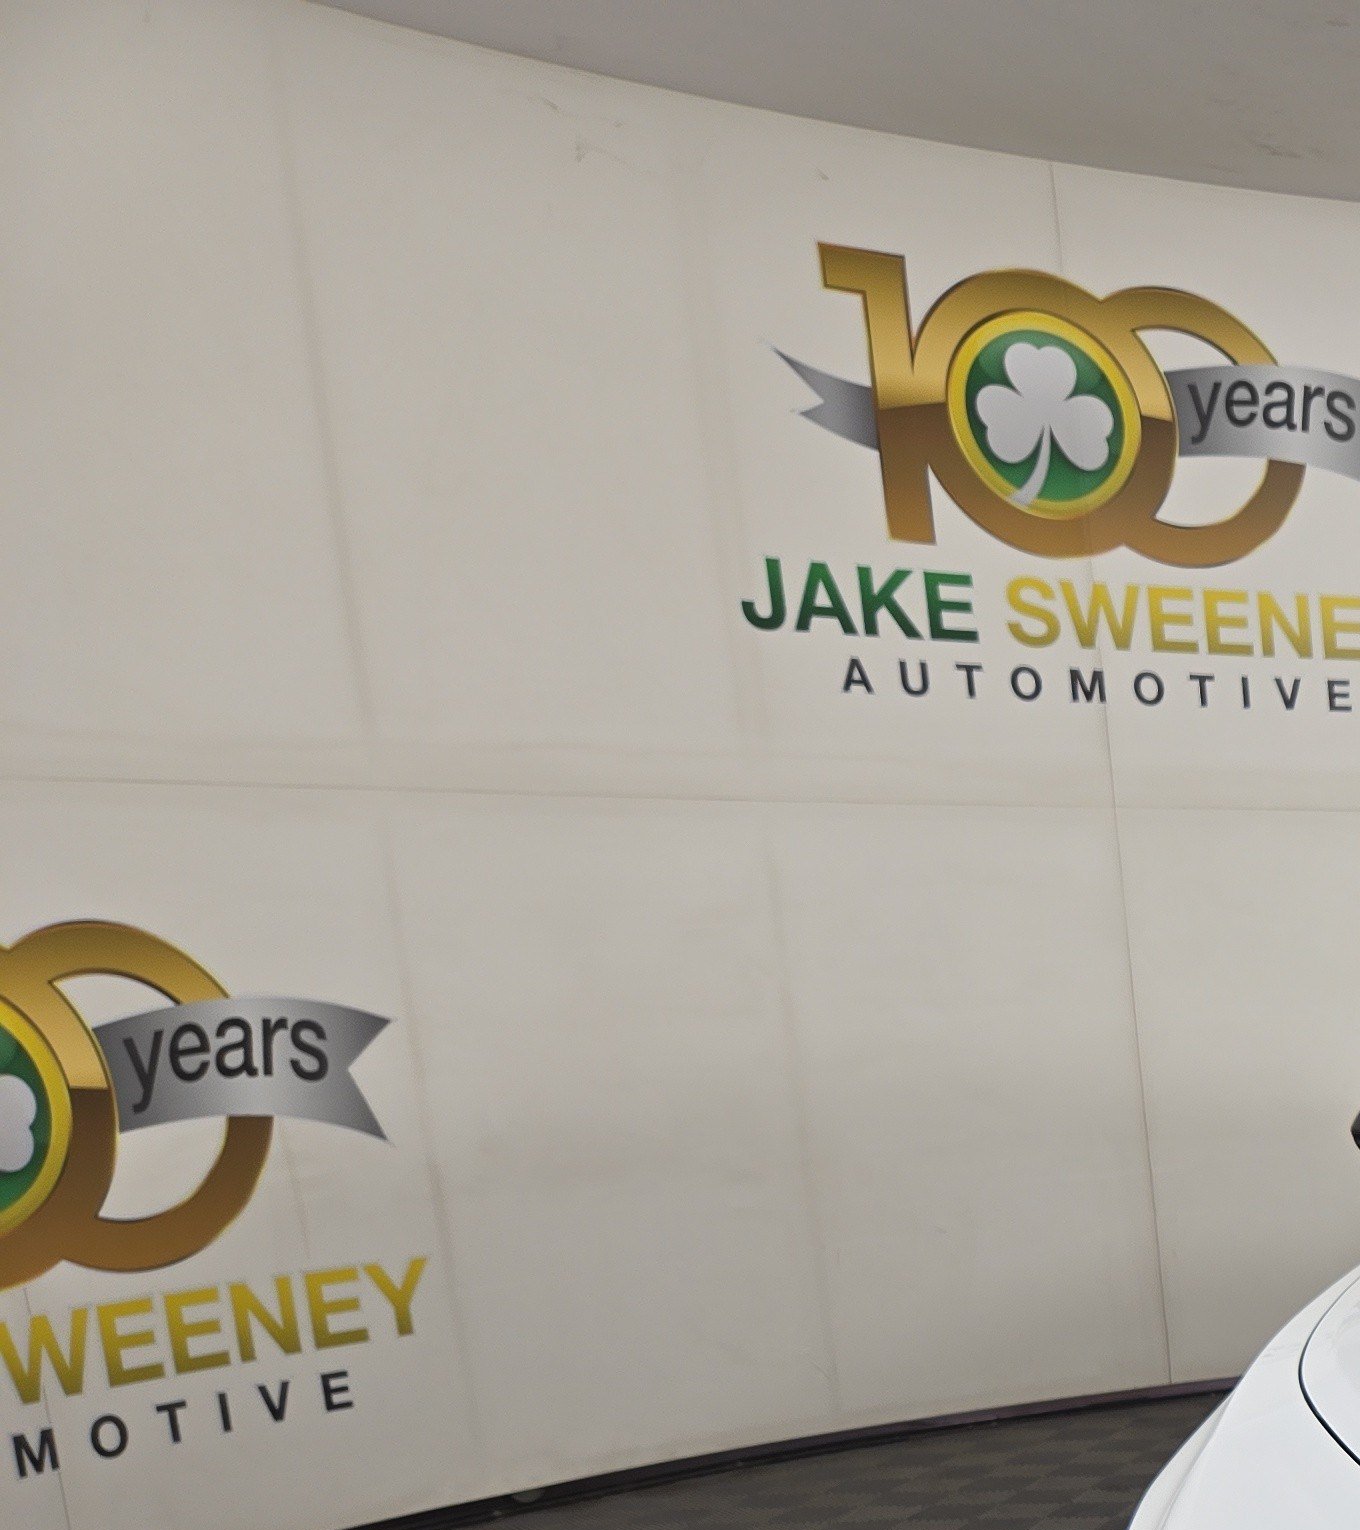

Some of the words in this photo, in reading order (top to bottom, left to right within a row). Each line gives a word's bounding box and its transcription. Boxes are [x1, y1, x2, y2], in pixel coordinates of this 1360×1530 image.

[817, 241, 1306, 569] 100
[1187, 378, 1357, 443] years
[741, 556, 980, 643] JAKE
[842, 655, 1354, 713] AUTOMOTIVE
[122, 1015, 329, 1114] years
[0, 1256, 429, 1405] WEENEY
[13, 1370, 354, 1480] MOTIVE
